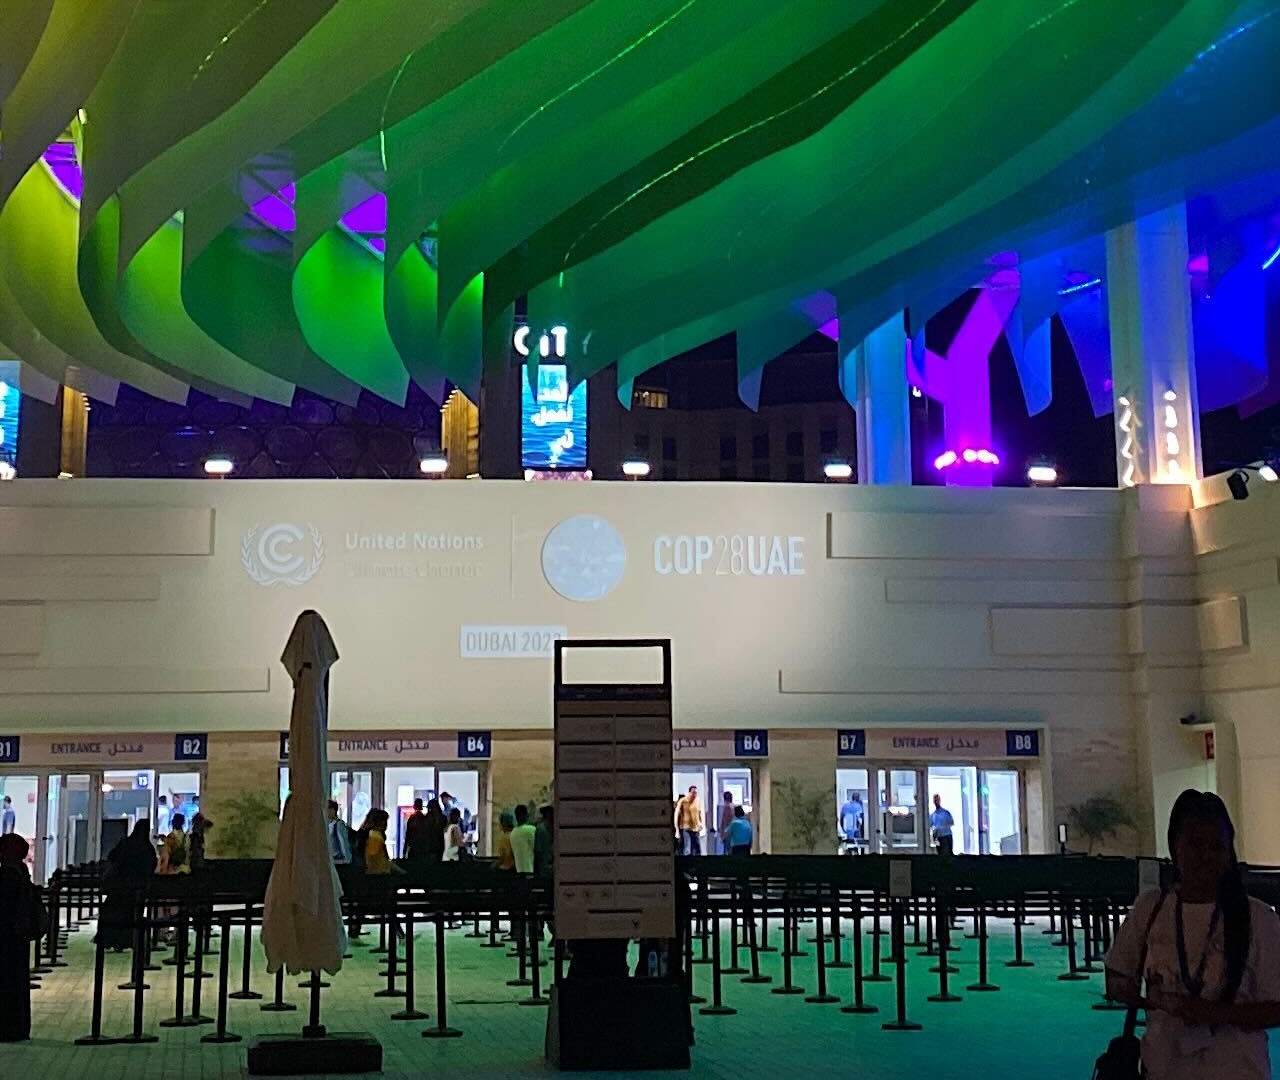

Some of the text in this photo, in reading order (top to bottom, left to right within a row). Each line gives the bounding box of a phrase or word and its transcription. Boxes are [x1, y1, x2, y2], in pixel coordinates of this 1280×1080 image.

[345, 531, 484, 549] United Nations
[654, 534, 806, 575] COP28UAE
[466, 631, 516, 652] DUBAI
[51, 742, 101, 755] ENTRANCE
[183, 739, 201, 755] B2
[338, 739, 388, 752] ENTRANCE
[395, 740, 430, 754] مدخل
[467, 736, 484, 752] B4
[743, 735, 761, 751] B6
[840, 735, 856, 750] B7
[892, 736, 940, 749] ENTRANCE
[1015, 735, 1032, 750] B8
